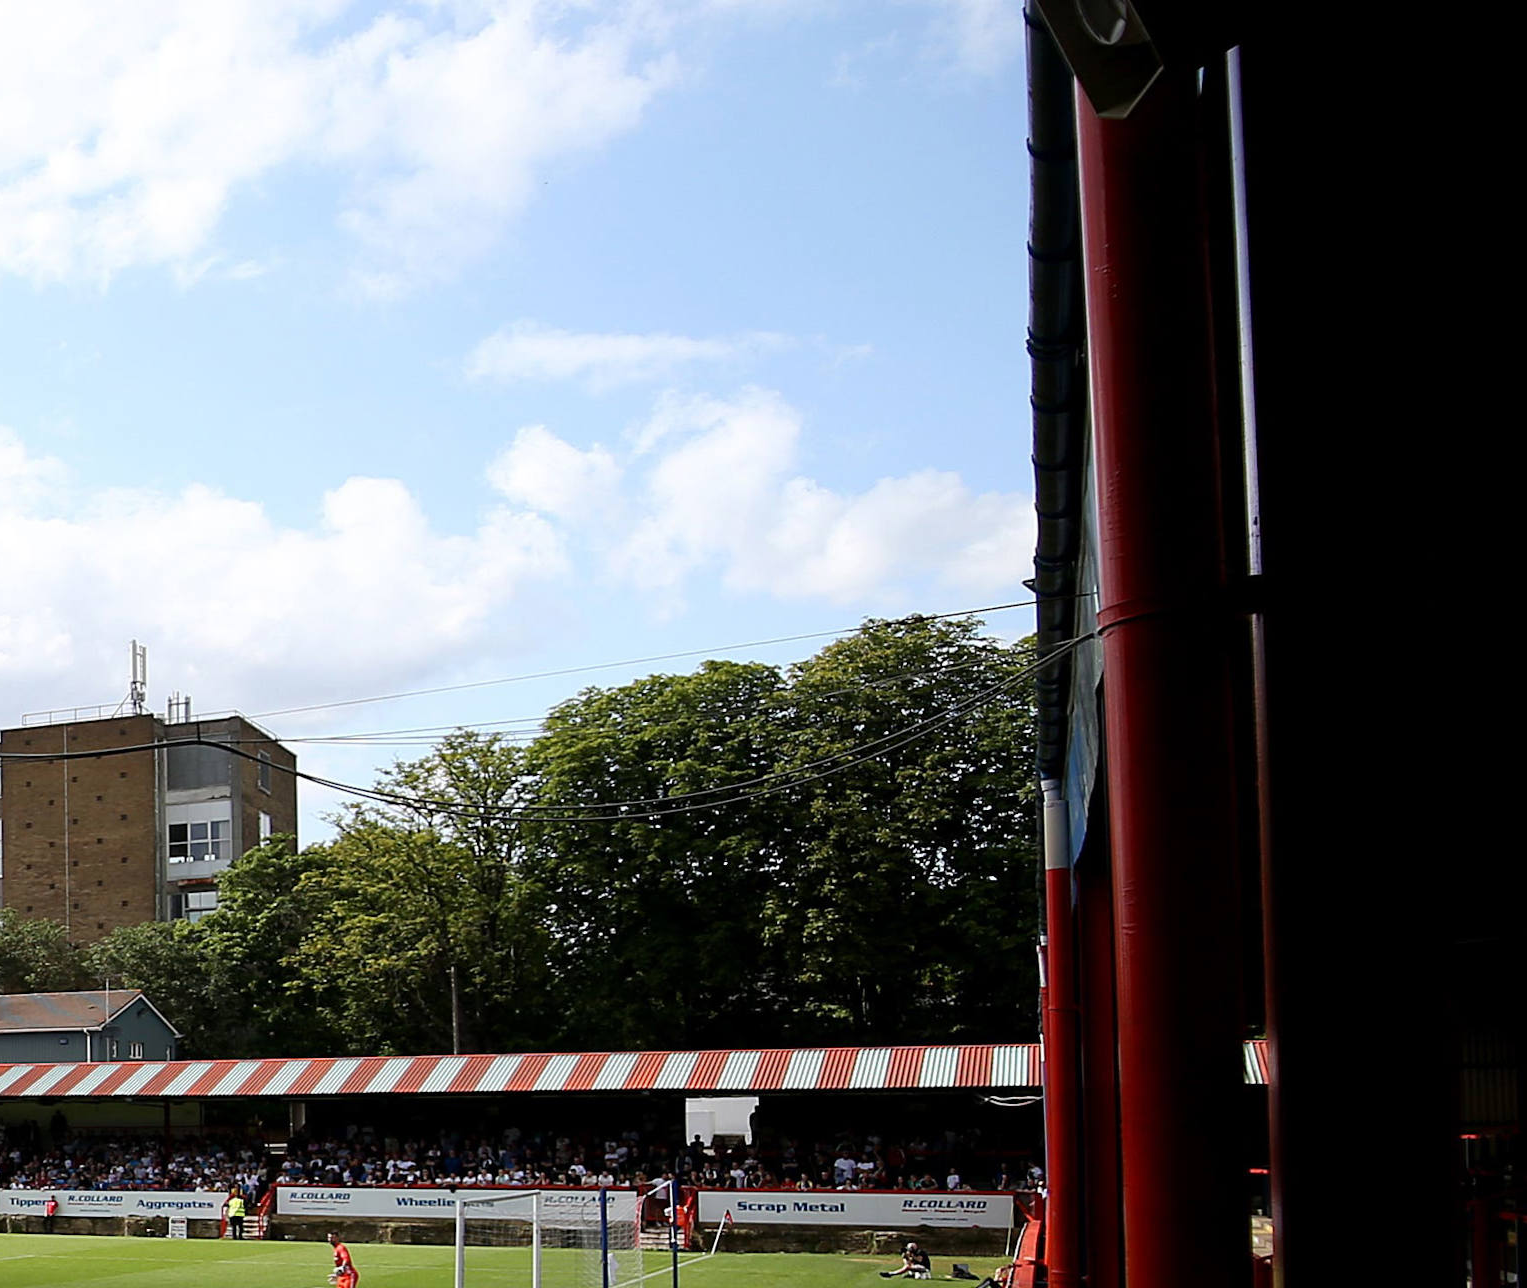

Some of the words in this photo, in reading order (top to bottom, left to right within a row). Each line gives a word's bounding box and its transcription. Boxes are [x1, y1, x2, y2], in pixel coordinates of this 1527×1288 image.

[68, 1195, 123, 1203] R.COLLARD
[289, 1192, 351, 1200] R.COLLARD
[9, 1197, 46, 1207] Tipper
[137, 1199, 214, 1210] Aggregates
[396, 1198, 456, 1207] Wheelie
[903, 1200, 987, 1209] R.COLLARD
[737, 1201, 787, 1213] Scrap
[793, 1202, 845, 1213] Metal
